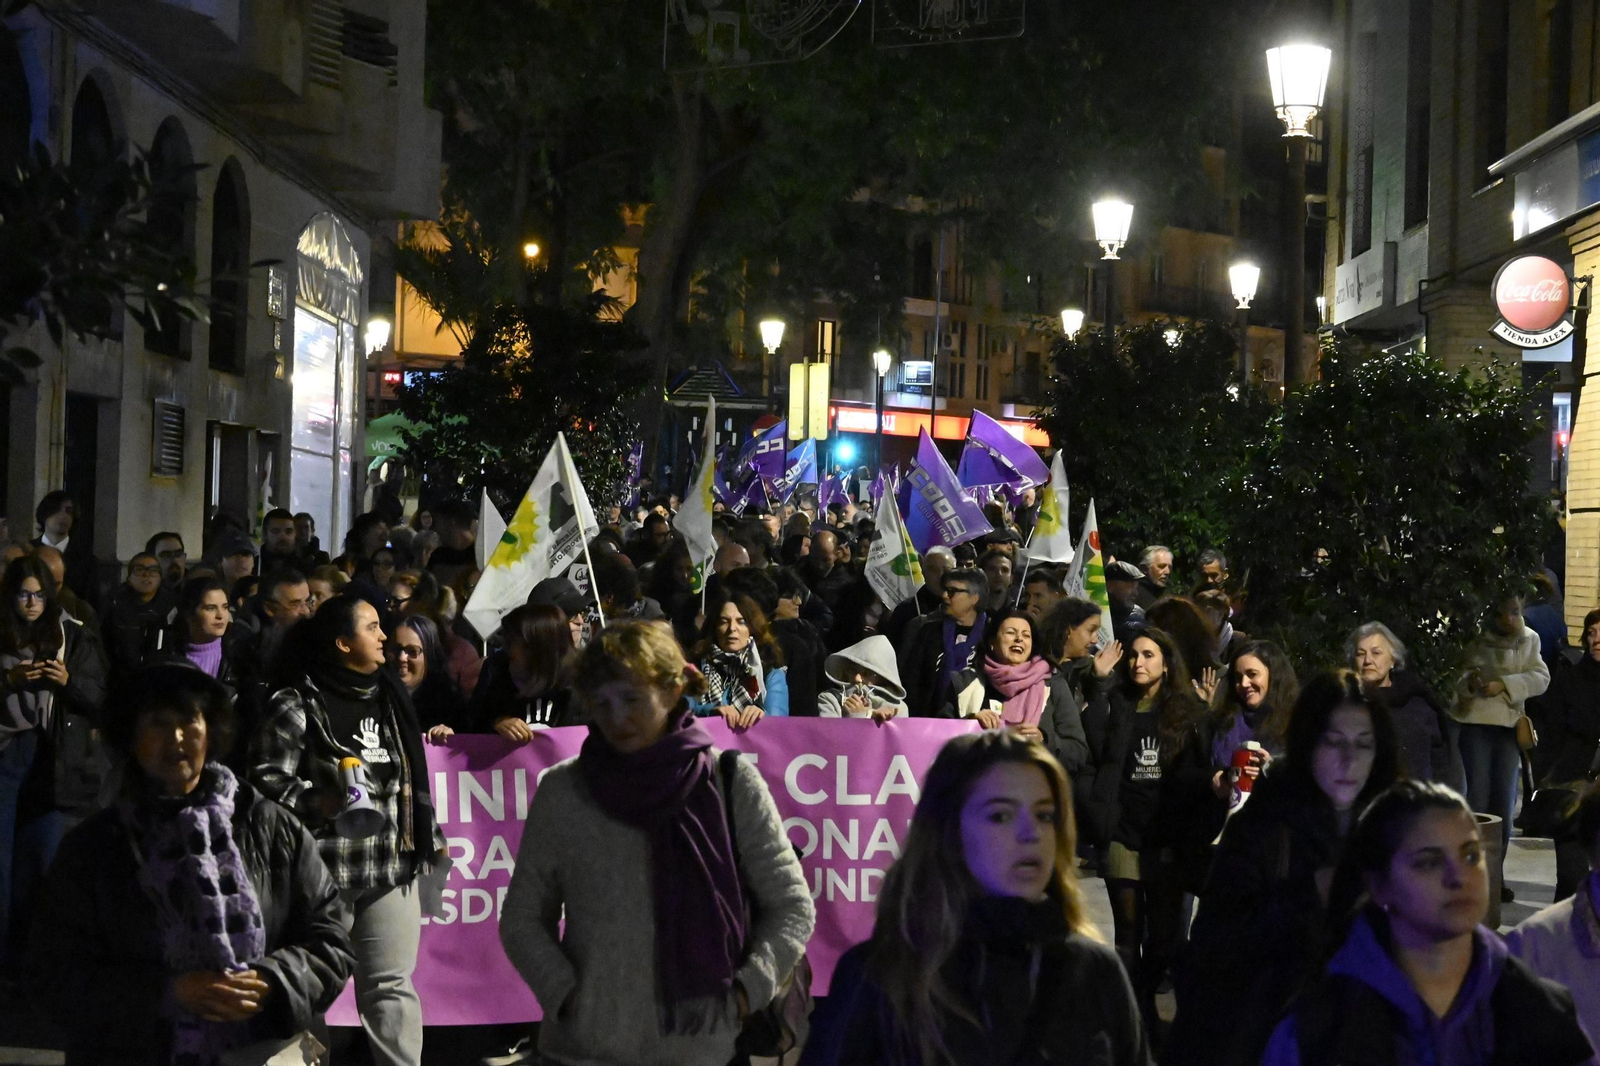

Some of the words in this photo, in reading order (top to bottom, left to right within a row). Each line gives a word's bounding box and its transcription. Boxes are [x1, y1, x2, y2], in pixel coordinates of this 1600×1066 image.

[1503, 327, 1538, 345] TIENDA
[1542, 327, 1567, 344] ALEX
[435, 768, 544, 824] INI
[782, 816, 913, 861] ONA
